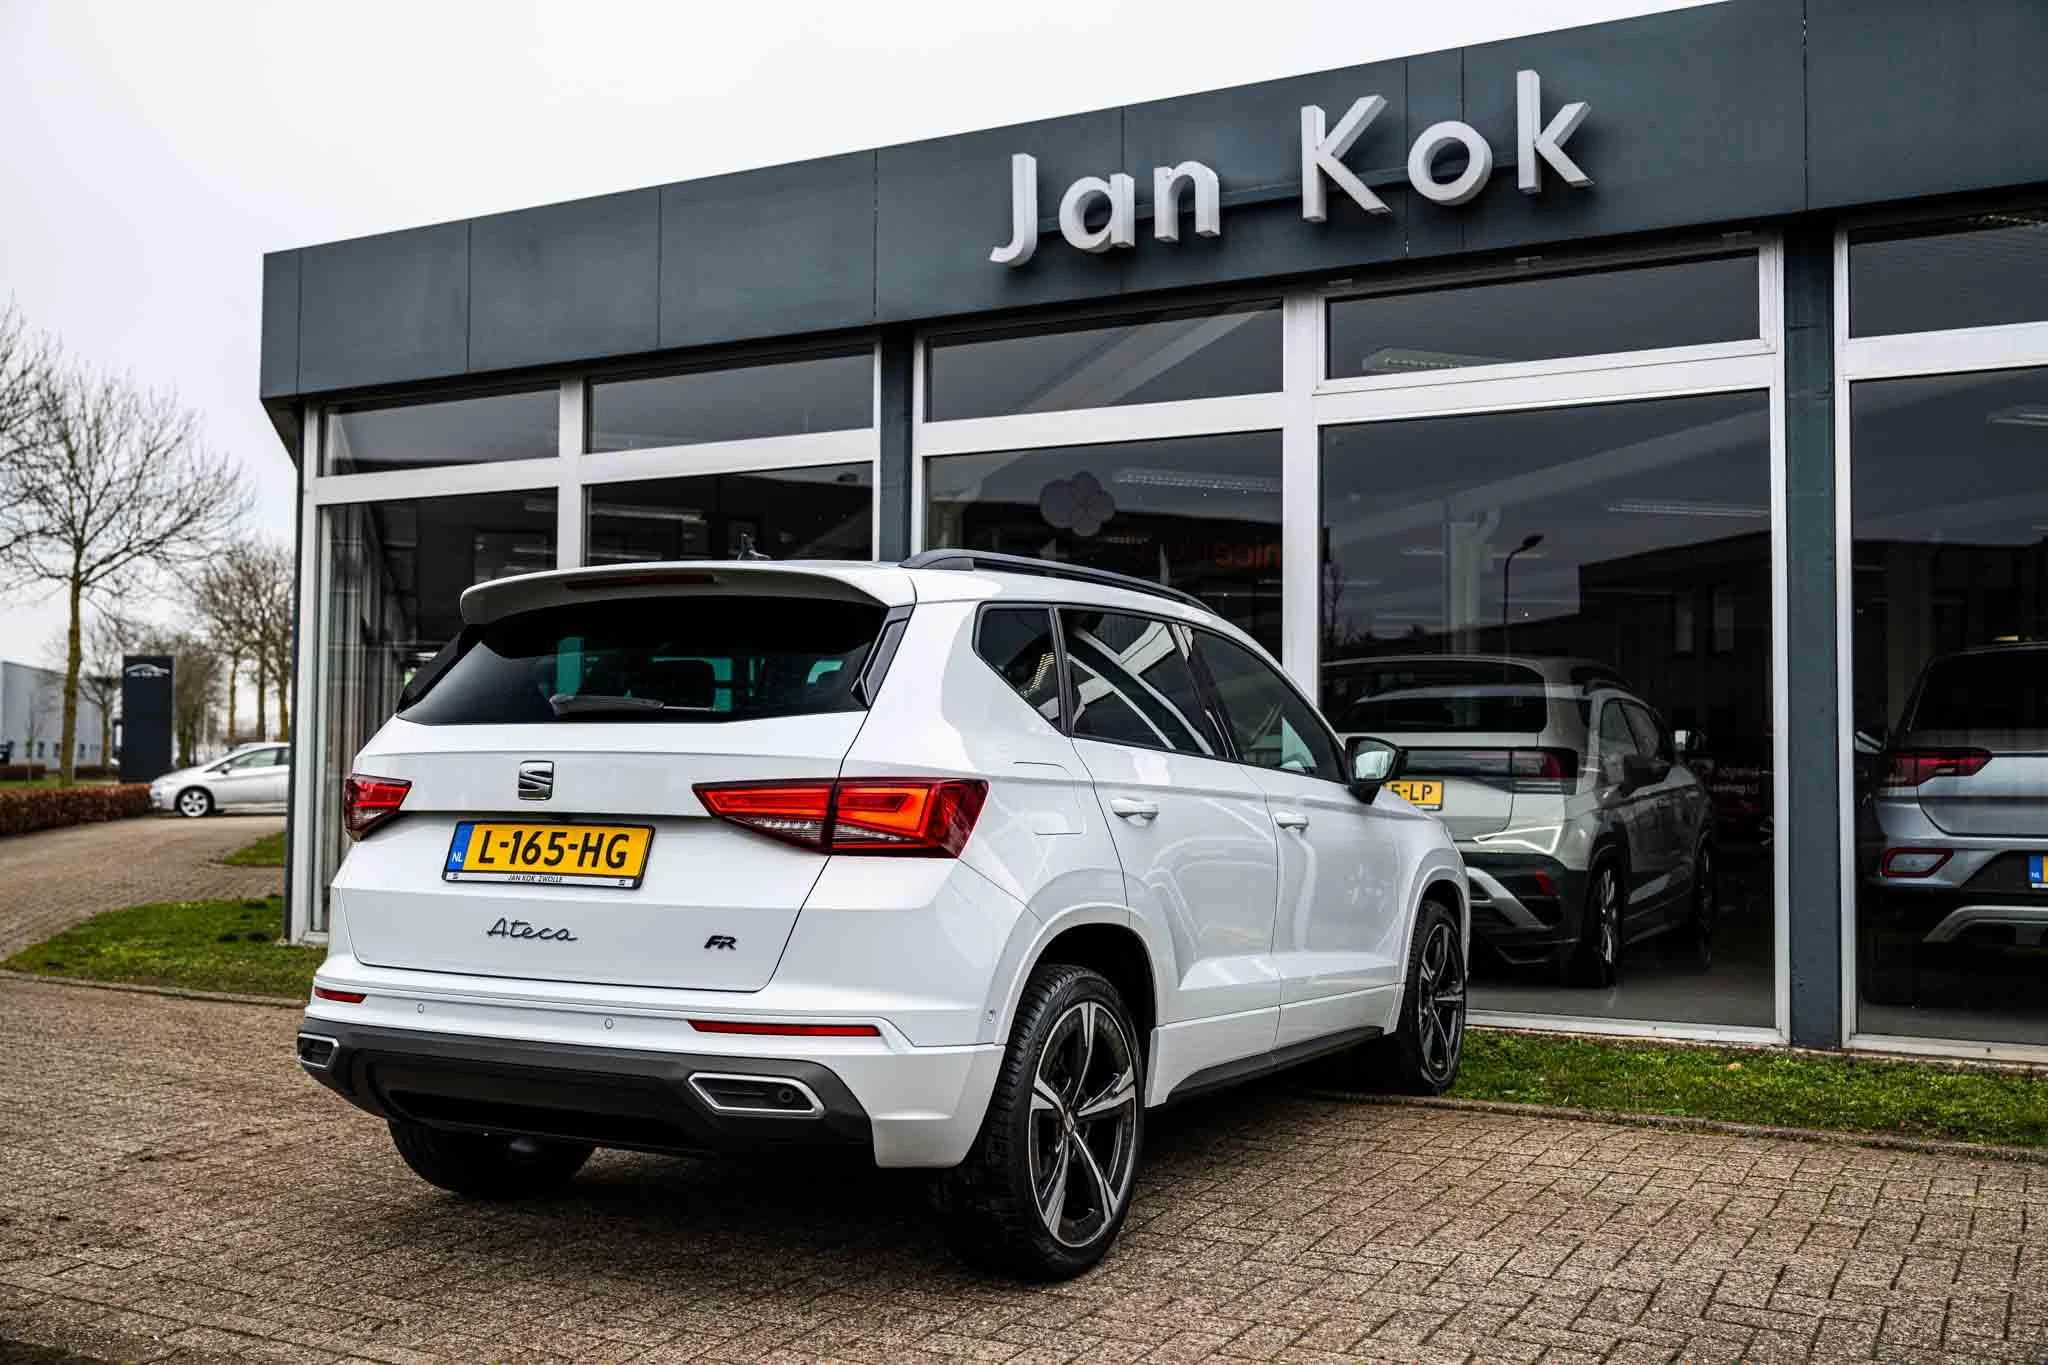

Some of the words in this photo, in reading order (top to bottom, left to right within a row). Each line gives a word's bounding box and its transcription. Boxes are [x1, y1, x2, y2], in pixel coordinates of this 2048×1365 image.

[989, 152, 1221, 267] Jan
[1300, 69, 1595, 222] Kok
[452, 852, 464, 863] NL
[478, 830, 630, 869] L-165-HG
[507, 873, 520, 881] JAN
[521, 874, 536, 882] KOK
[538, 875, 563, 883] ZWOLLE
[486, 917, 579, 943] Ateca
[704, 935, 737, 951] FR
